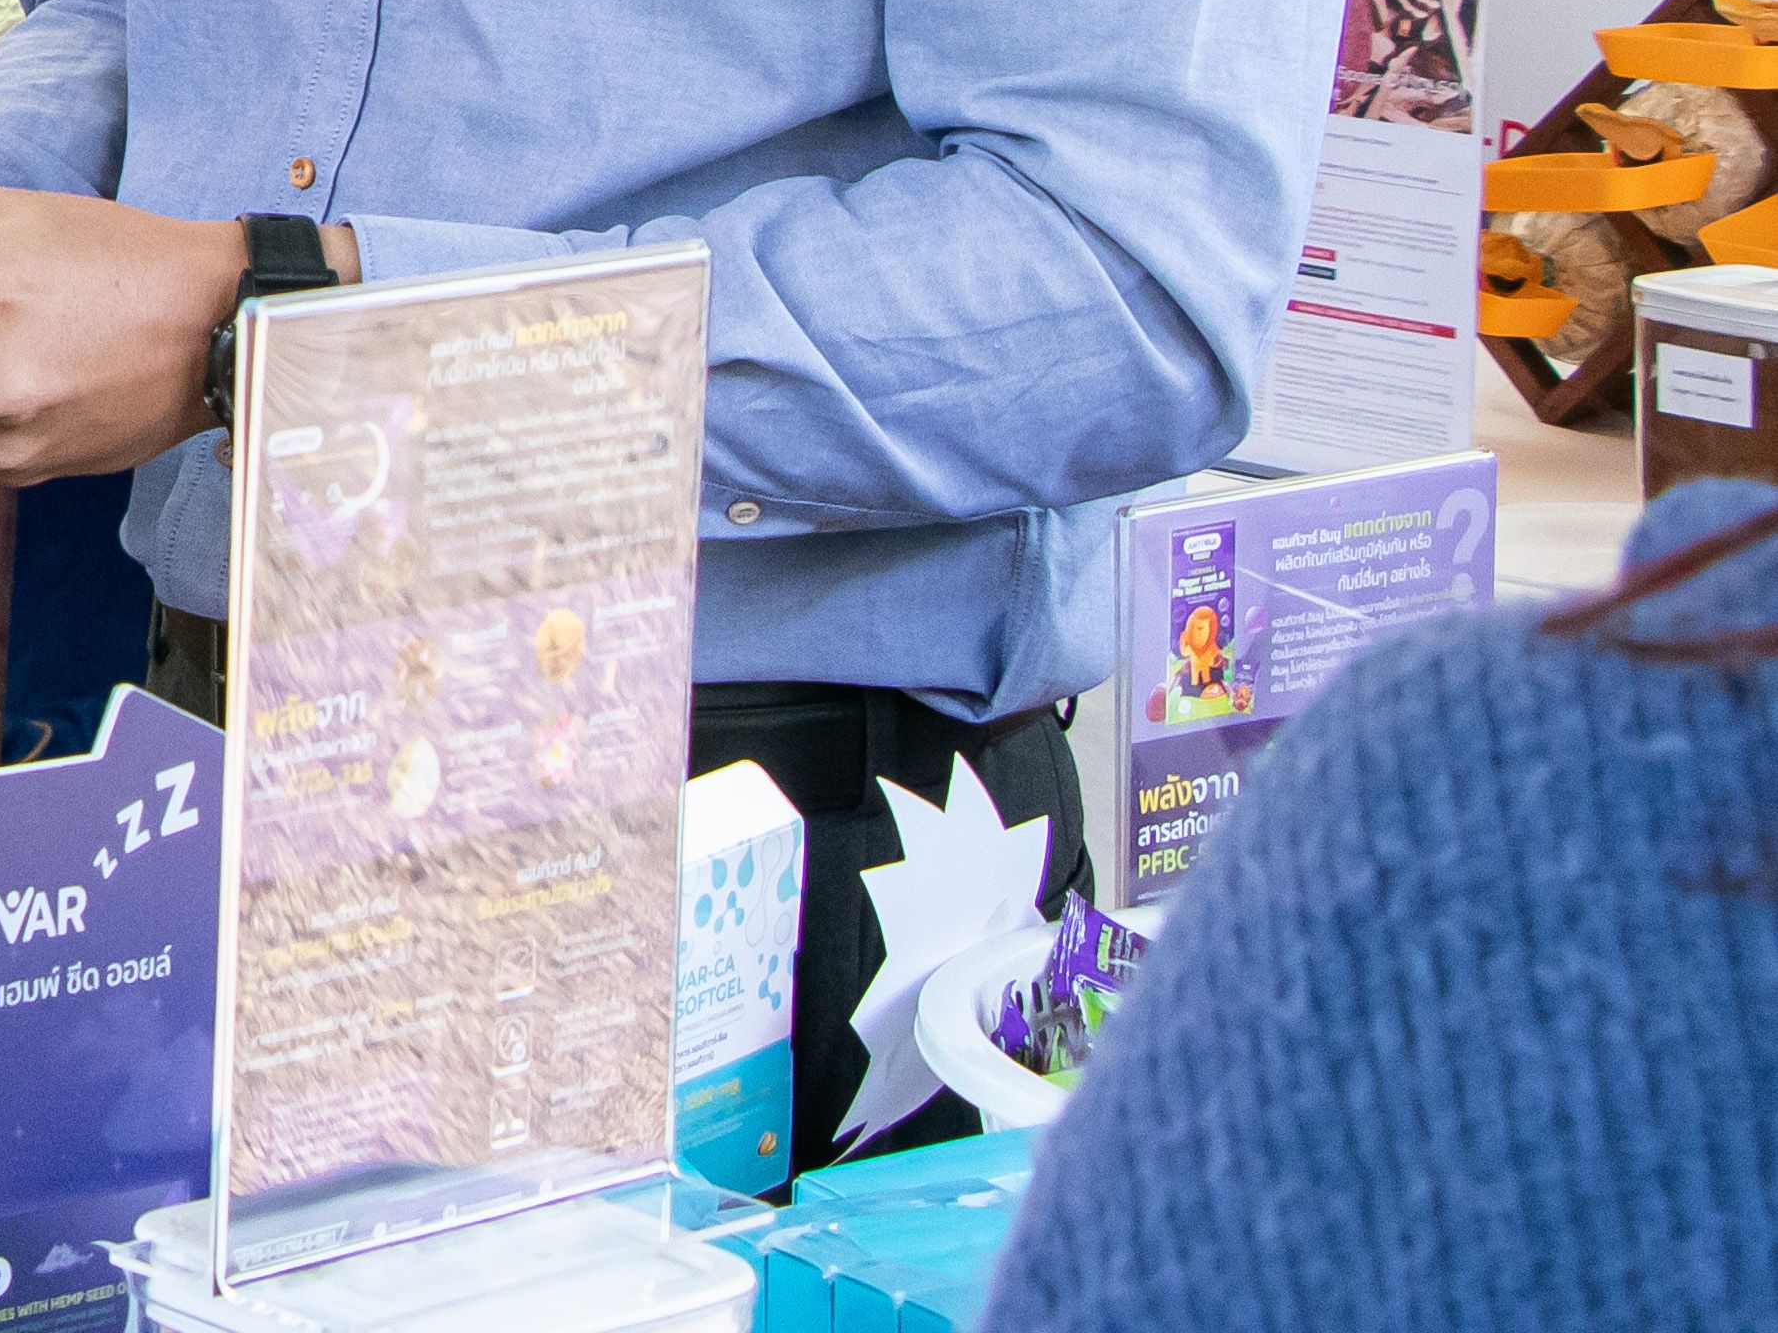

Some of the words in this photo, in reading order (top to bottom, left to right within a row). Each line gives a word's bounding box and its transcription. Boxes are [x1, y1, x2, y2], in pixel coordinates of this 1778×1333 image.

[1343, 509, 1432, 539] แตกต่างจาก
[1409, 532, 1433, 551] หรือ
[1138, 771, 1240, 815] พลังจาก
[0, 964, 60, 1008] เฮมพ์
[66, 960, 99, 996] ซีด
[106, 944, 174, 987] ออยล์
[676, 976, 745, 1020] SOFTGEL
[50, 1291, 85, 1311] HEMP
[85, 1284, 115, 1303] SEED
